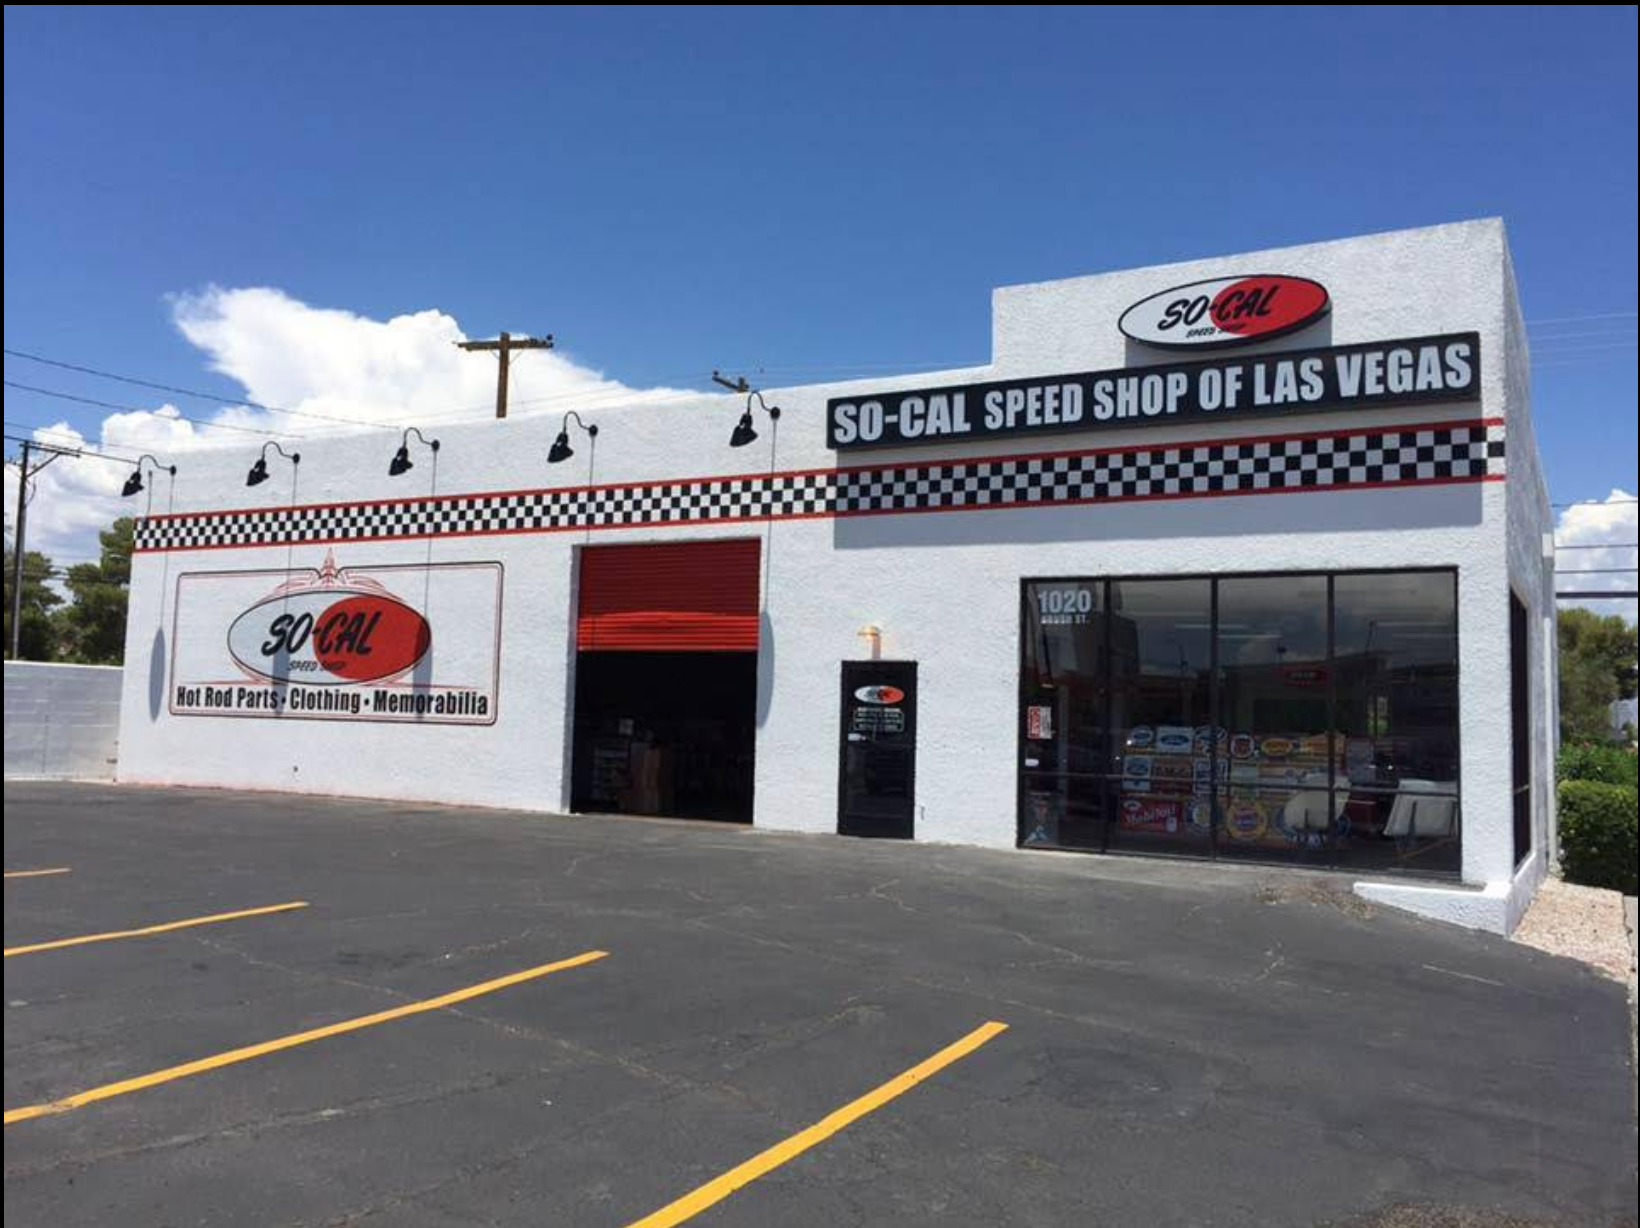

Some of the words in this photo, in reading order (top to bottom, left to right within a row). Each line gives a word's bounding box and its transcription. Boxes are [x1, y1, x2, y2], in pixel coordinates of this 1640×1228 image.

[1158, 286, 1279, 330] SO-CAL
[1186, 326, 1216, 338] SPEED
[834, 393, 971, 443] SO-CAL
[984, 383, 1083, 429] SPEED
[1093, 372, 1188, 420] SHOP
[1200, 366, 1243, 411] OF
[1254, 358, 1324, 406] LAS
[1335, 343, 1472, 398] VEGAS
[1038, 590, 1092, 613] 1020
[261, 610, 383, 656] SO-CAL
[288, 660, 318, 672] SPEED
[176, 686, 200, 708] Hot
[204, 687, 233, 708] Rod
[237, 688, 278, 710] Parts
[289, 688, 361, 714] Clothing
[373, 690, 488, 716] Memorabilia
